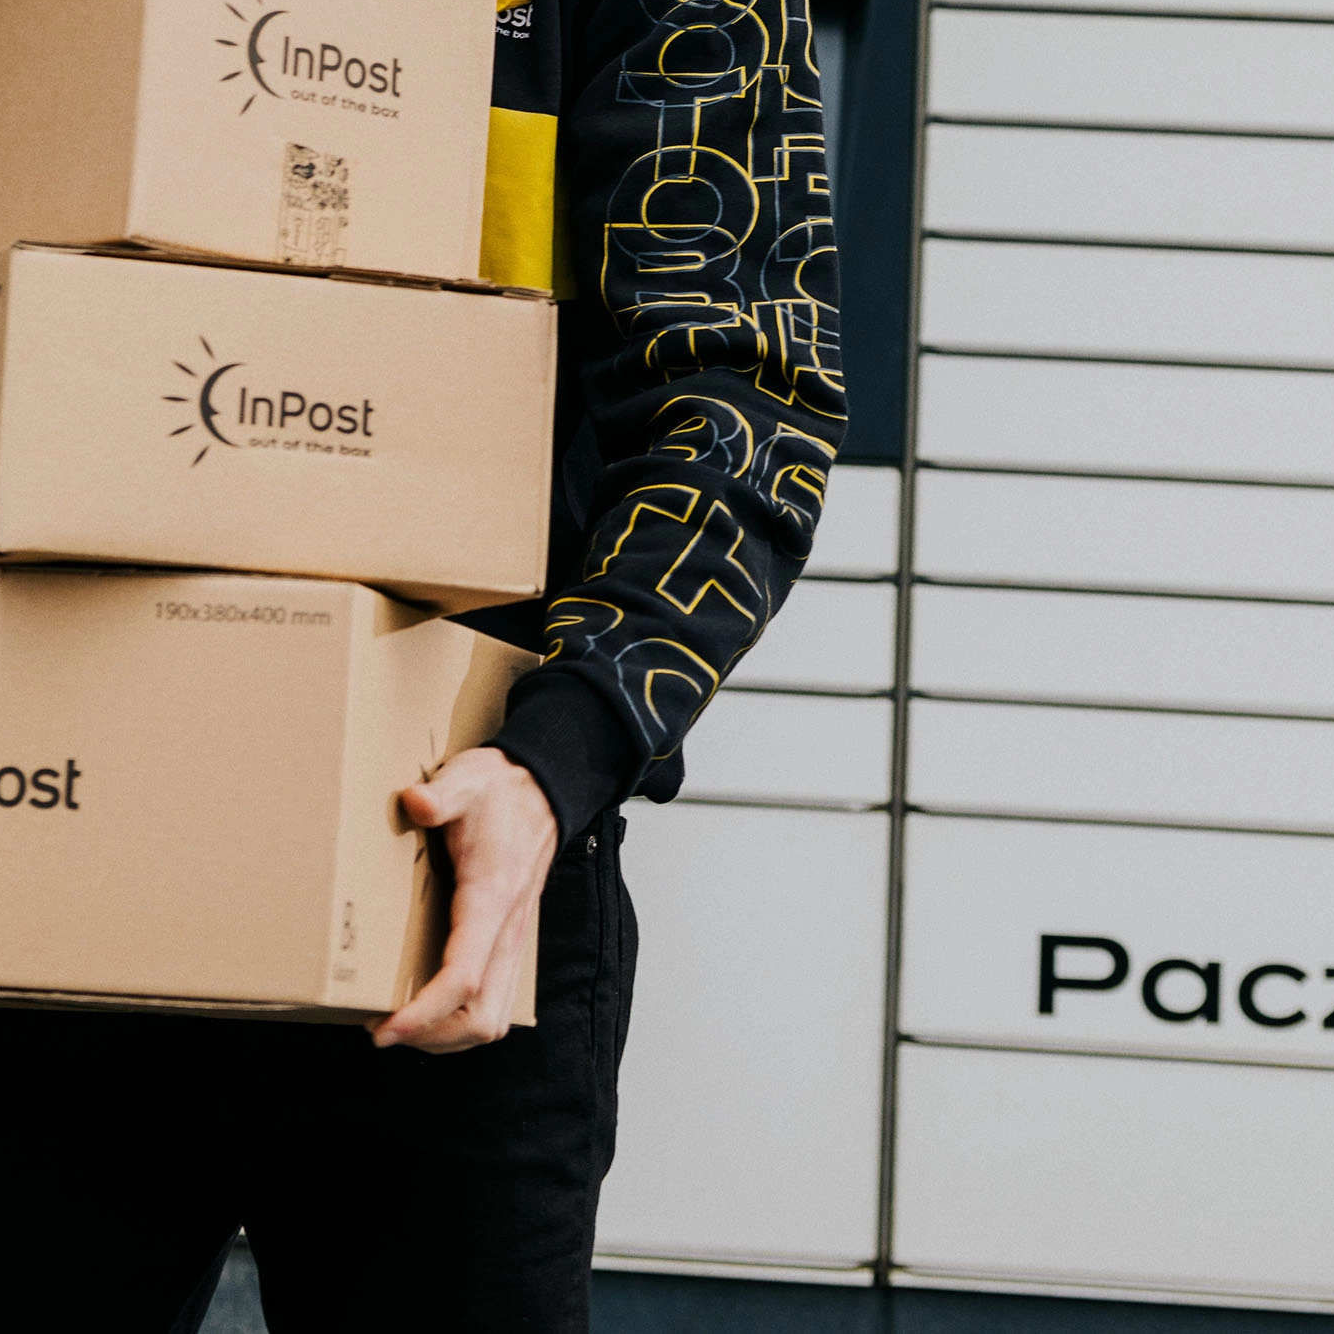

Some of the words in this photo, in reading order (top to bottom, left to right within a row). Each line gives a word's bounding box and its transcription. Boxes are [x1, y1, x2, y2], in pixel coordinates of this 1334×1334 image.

[282, 36, 403, 98] InPost
[291, 89, 317, 103] out
[321, 94, 336, 107] of
[341, 97, 366, 113] the
[371, 102, 400, 119] box
[239, 387, 375, 436] InPost
[249, 437, 277, 448] out
[283, 439, 300, 450] of
[305, 441, 333, 454] the
[339, 443, 371, 457] box
[155, 601, 286, 625] 190x380x400
[291, 611, 331, 625] mm
